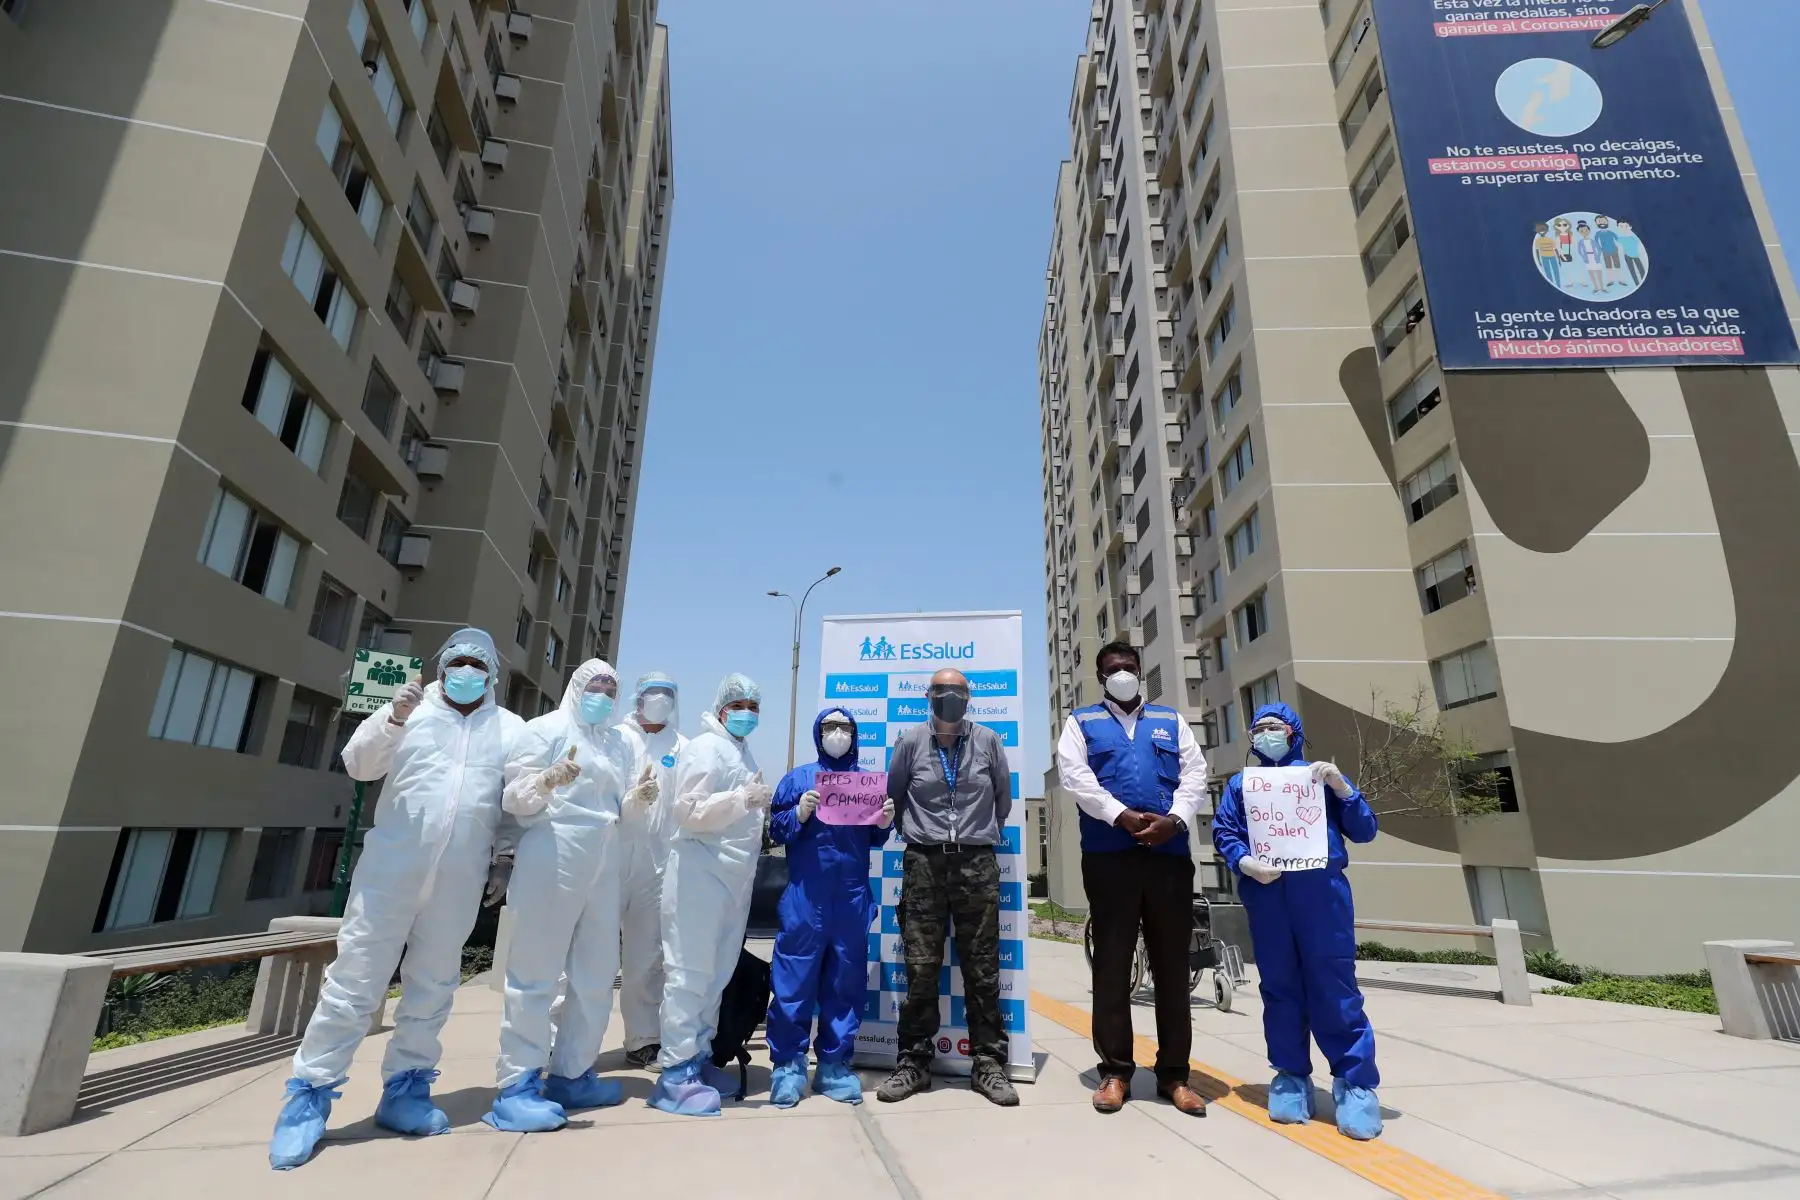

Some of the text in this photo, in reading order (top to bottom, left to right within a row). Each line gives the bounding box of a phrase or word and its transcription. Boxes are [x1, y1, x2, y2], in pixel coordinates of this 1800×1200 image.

[1445, 5, 1611, 25] ganar medallas, sino
[1438, 22, 1499, 38] ganarle
[1502, 22, 1518, 32] al
[1446, 138, 1681, 157] No te asustes, no decaigas,
[1431, 151, 1704, 173] estamos contigo para ayudarte
[1461, 167, 1681, 187] a superar este momento.
[1474, 306, 1740, 326] La gente luchadora es la que
[1477, 320, 1746, 342] inspira y da sentido a la vida.
[1491, 336, 1740, 358] ¡Mucho ánimo luchadores!
[900, 641, 974, 660] EsSalud
[850, 683, 879, 692] EsSalud
[977, 681, 1008, 691] EsSalud
[366, 697, 391, 705] PUN
[977, 706, 1008, 715] EsSalud
[858, 732, 877, 740] Salud
[1246, 776, 1272, 793] De
[1250, 802, 1284, 822] Solo
[1253, 839, 1272, 856] los
